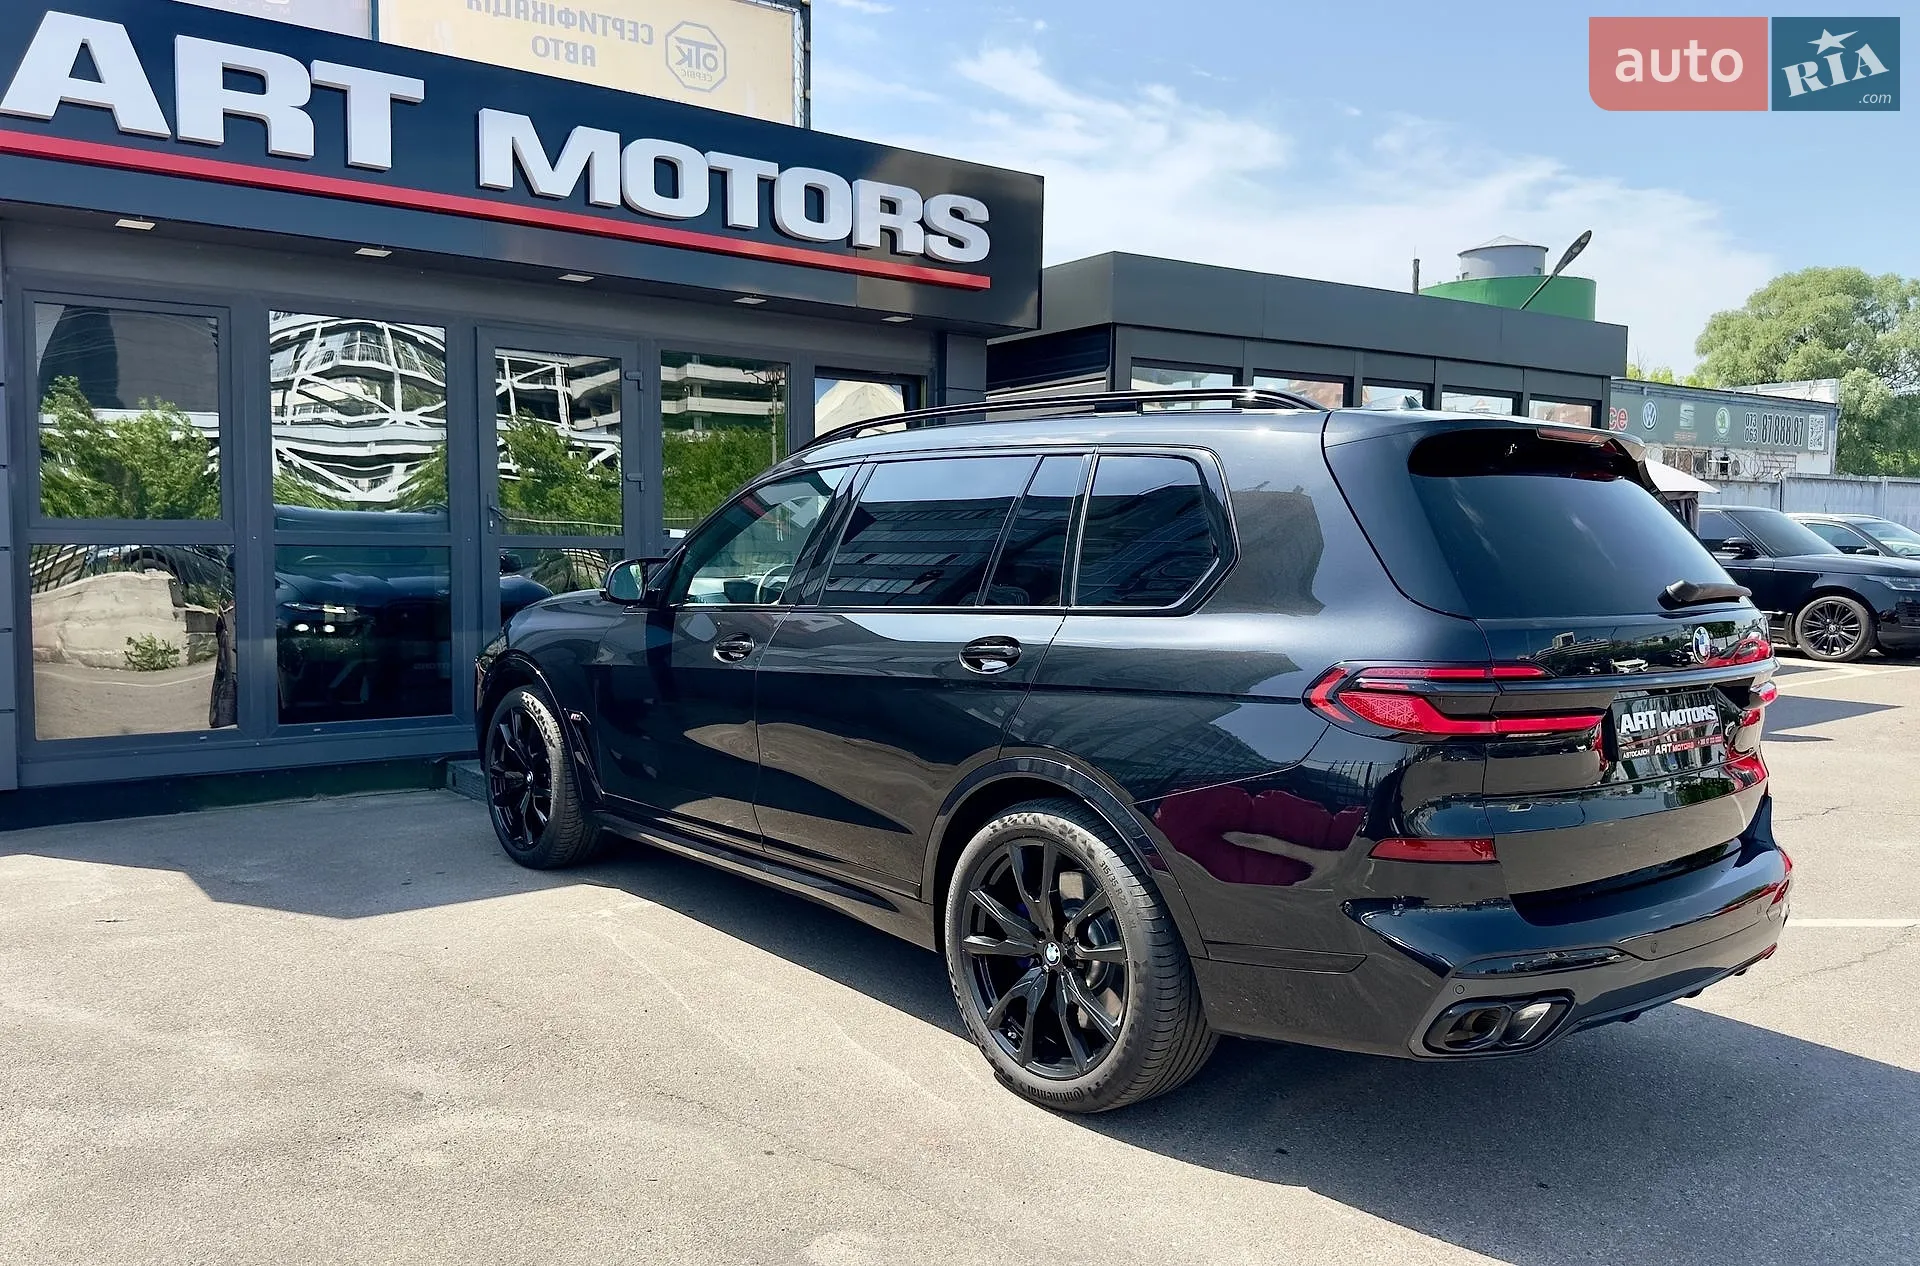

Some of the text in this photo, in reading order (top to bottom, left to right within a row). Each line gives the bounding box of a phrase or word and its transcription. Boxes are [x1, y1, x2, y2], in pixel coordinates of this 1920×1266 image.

[0, 10, 991, 264] ART MOTORS
[1620, 704, 1718, 734] ART MOTORS
